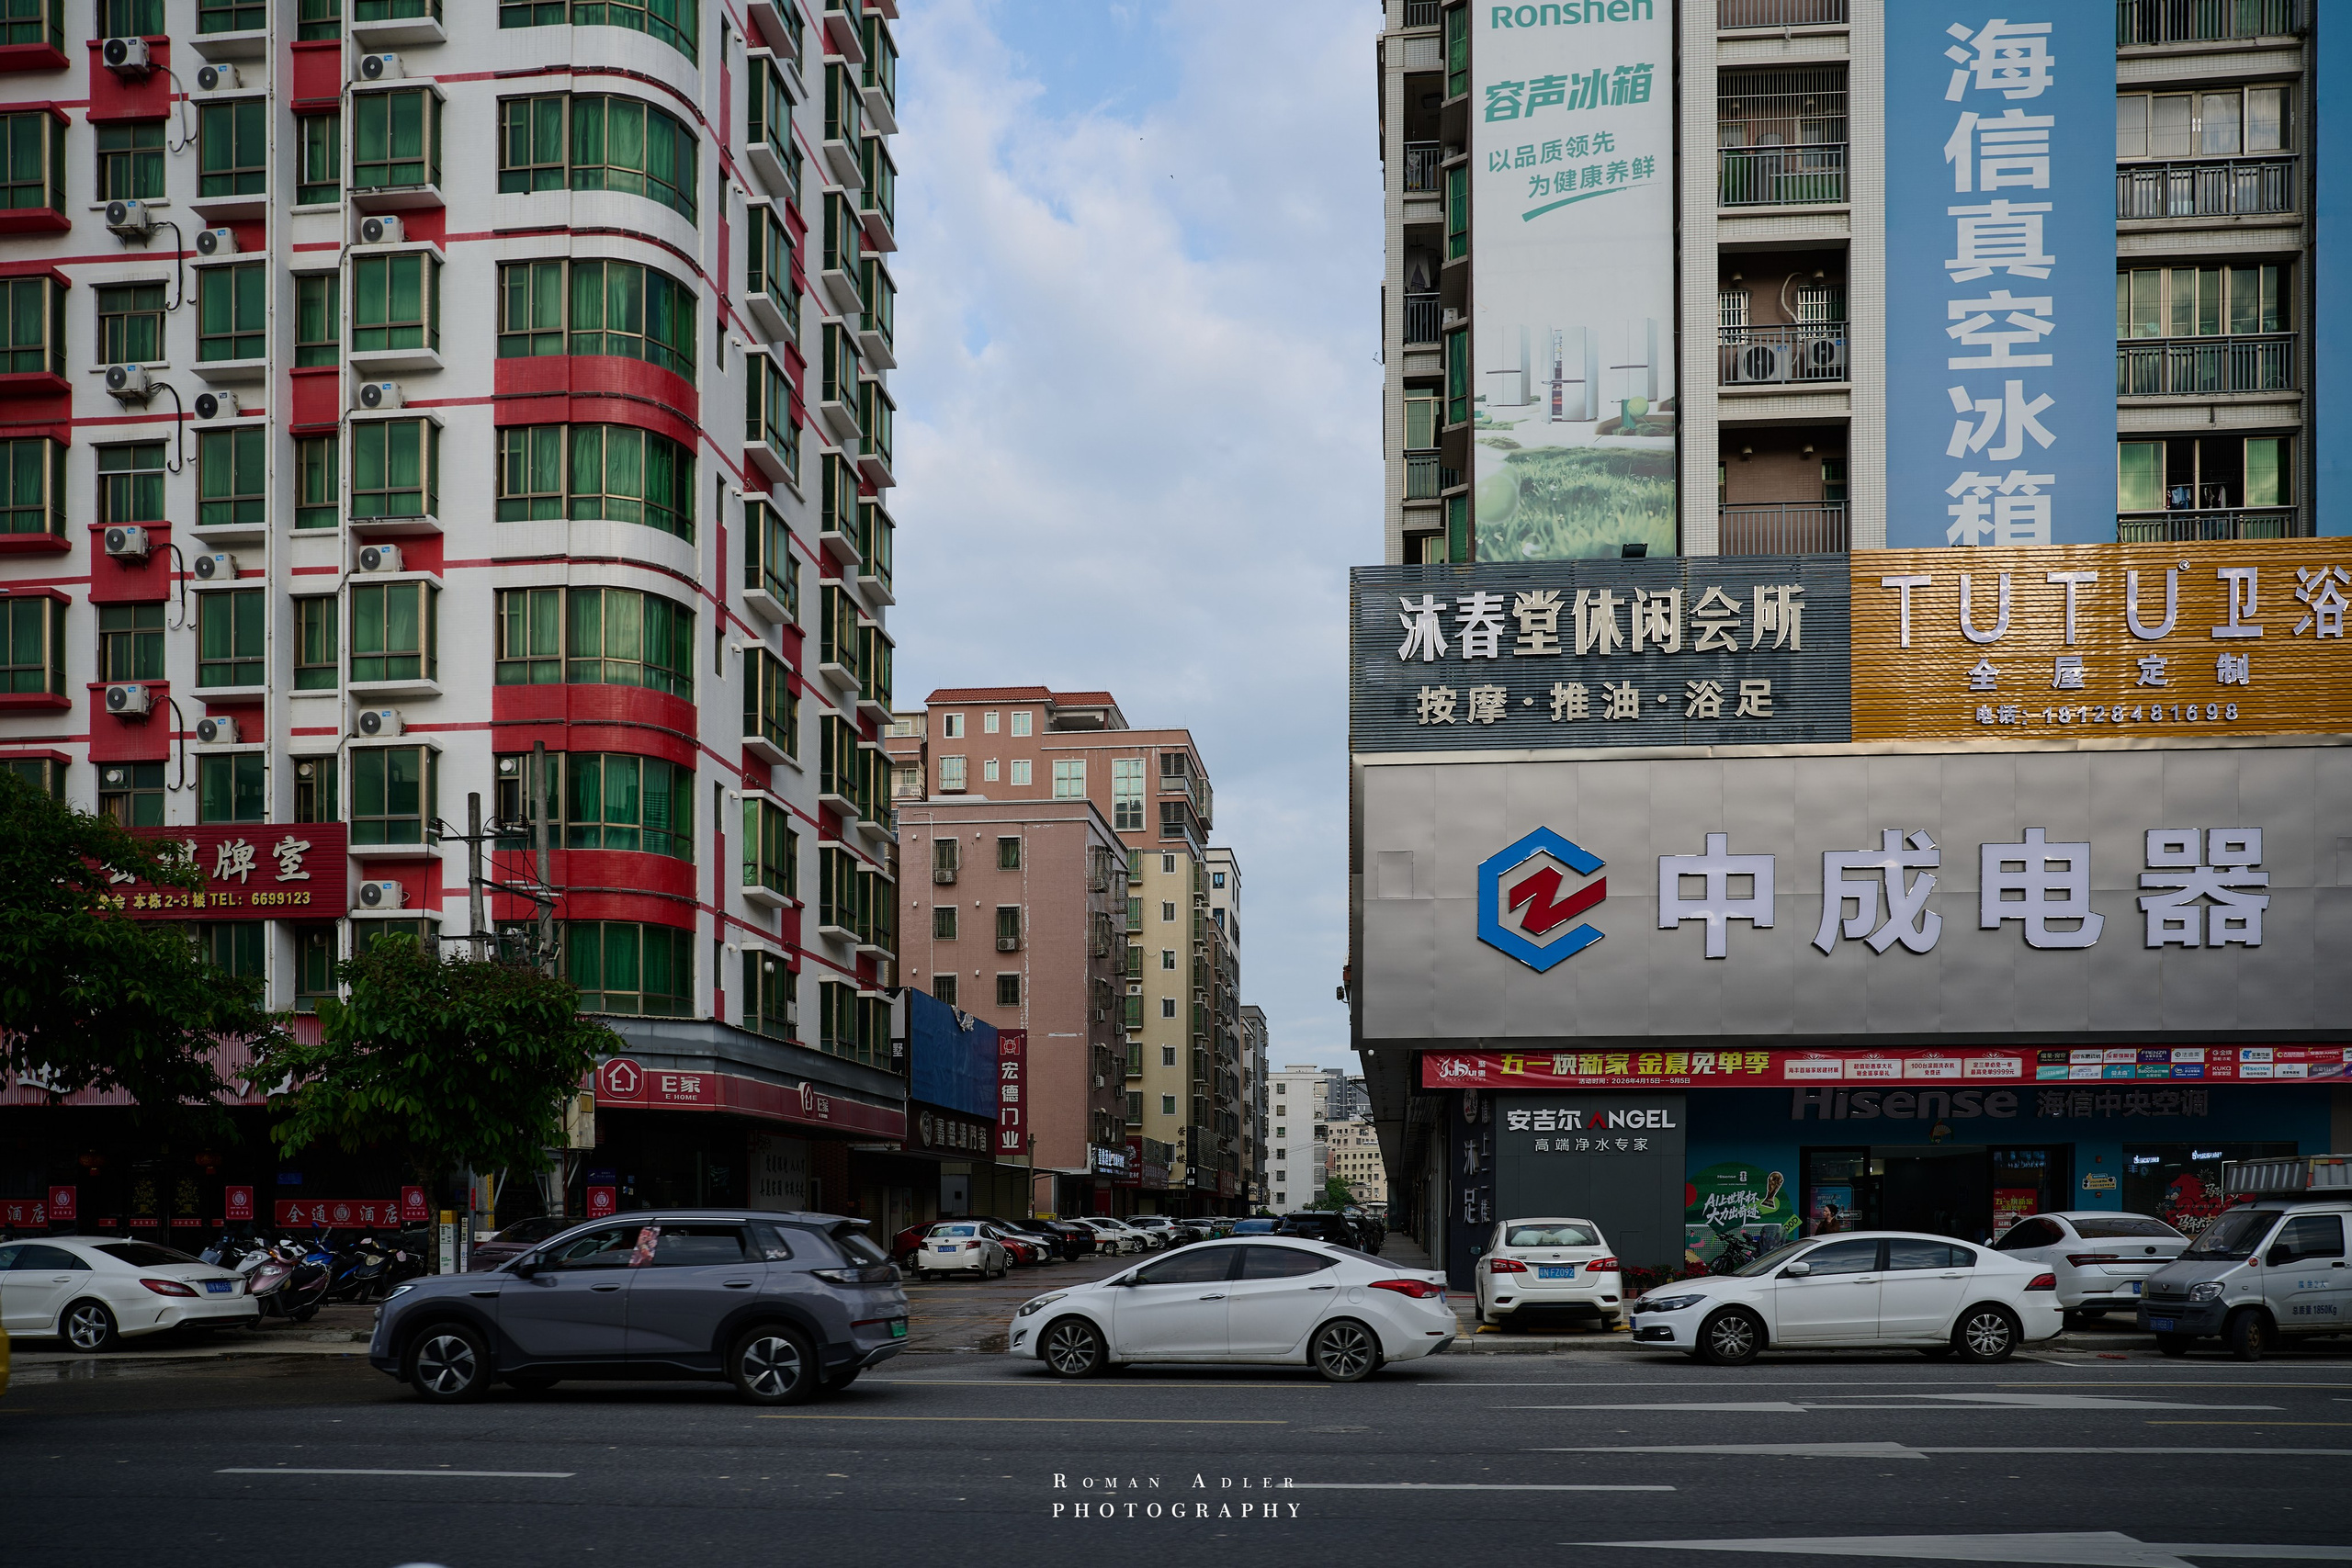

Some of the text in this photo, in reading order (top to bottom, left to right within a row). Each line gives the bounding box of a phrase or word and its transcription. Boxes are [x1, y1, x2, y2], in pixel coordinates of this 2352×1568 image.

[1492, 0, 1653, 28] Ronshen
[1485, 62, 1655, 123] 容声冰箱
[1487, 130, 1615, 174] 以品质领先
[1529, 154, 1656, 198] 为健康养鲜
[1943, 18, 2056, 547] 海信真空冰箱
[1396, 583, 1805, 662] 沐春堂休闲会所
[1881, 564, 2350, 649] TUTU 卫浴
[1968, 651, 2250, 691] 全屋定制
[1417, 679, 1775, 726] 按摩·推油·浴足
[2042, 701, 2239, 725] 18128481698
[251, 891, 311, 906] 6699123
[1657, 826, 2272, 960] 中成电器
[1500, 1051, 1770, 1076] 五一焕新家 金夏免单季
[662, 1075, 701, 1094] E家
[1001, 1061, 1020, 1149] 宏德门业
[1507, 1108, 1677, 1132] 安吉尔 ANGEL
[1791, 1087, 2018, 1120] Hisense
[2036, 1089, 2209, 1118] 海信中央空调
[1176, 1124, 1187, 1165] 荣华楼
[1534, 1137, 1648, 1152] 高端净水专家
[1464, 1139, 1480, 1224] 沐足
[6, 1203, 46, 1224] 酒店
[287, 1203, 399, 1224] 全通 酒店
[1706, 1205, 1761, 1226] 大力出奇迹
[2292, 1303, 2337, 1316] 总质量 1850Kg
